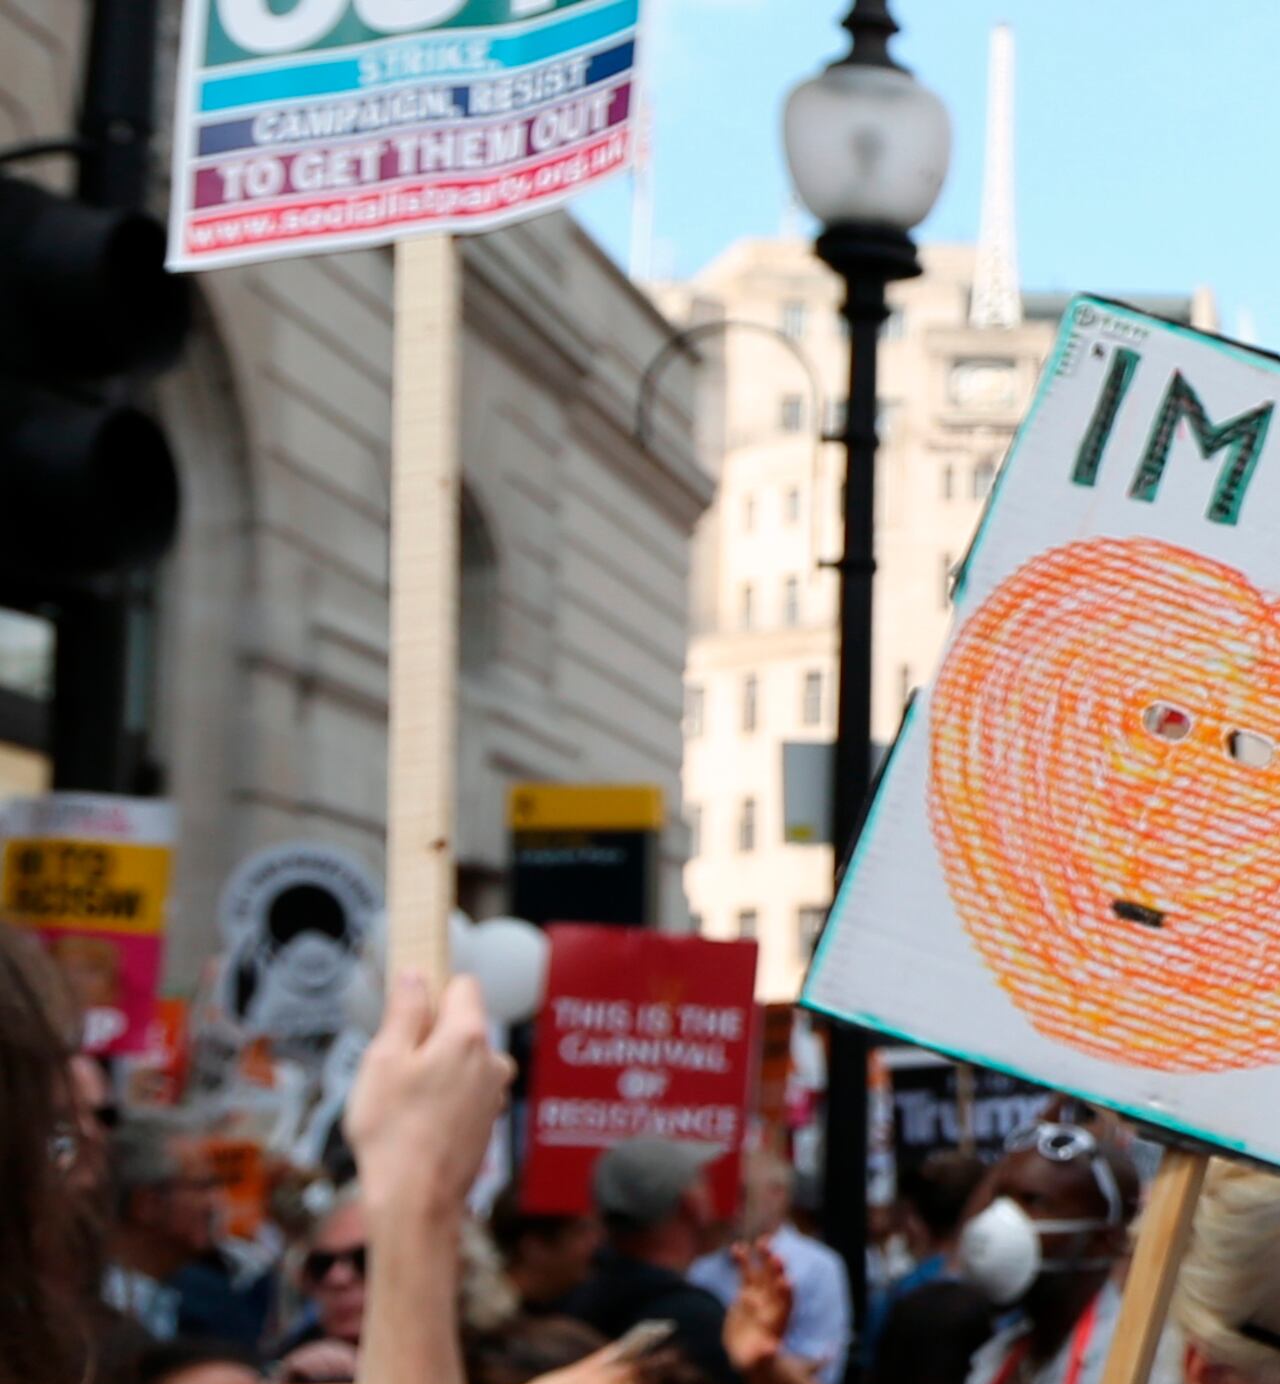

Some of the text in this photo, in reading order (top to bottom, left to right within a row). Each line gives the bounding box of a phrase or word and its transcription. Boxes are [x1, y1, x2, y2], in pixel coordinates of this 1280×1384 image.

[251, 56, 592, 145] CAMPAIGN, RESIST
[215, 88, 618, 202] TO GET THEM OUT
[553, 997, 744, 1041] THIS IS THE
[557, 1031, 731, 1075] CARNIVAL
[615, 1066, 670, 1101] OF
[536, 1097, 738, 1136] RESISTANCE
